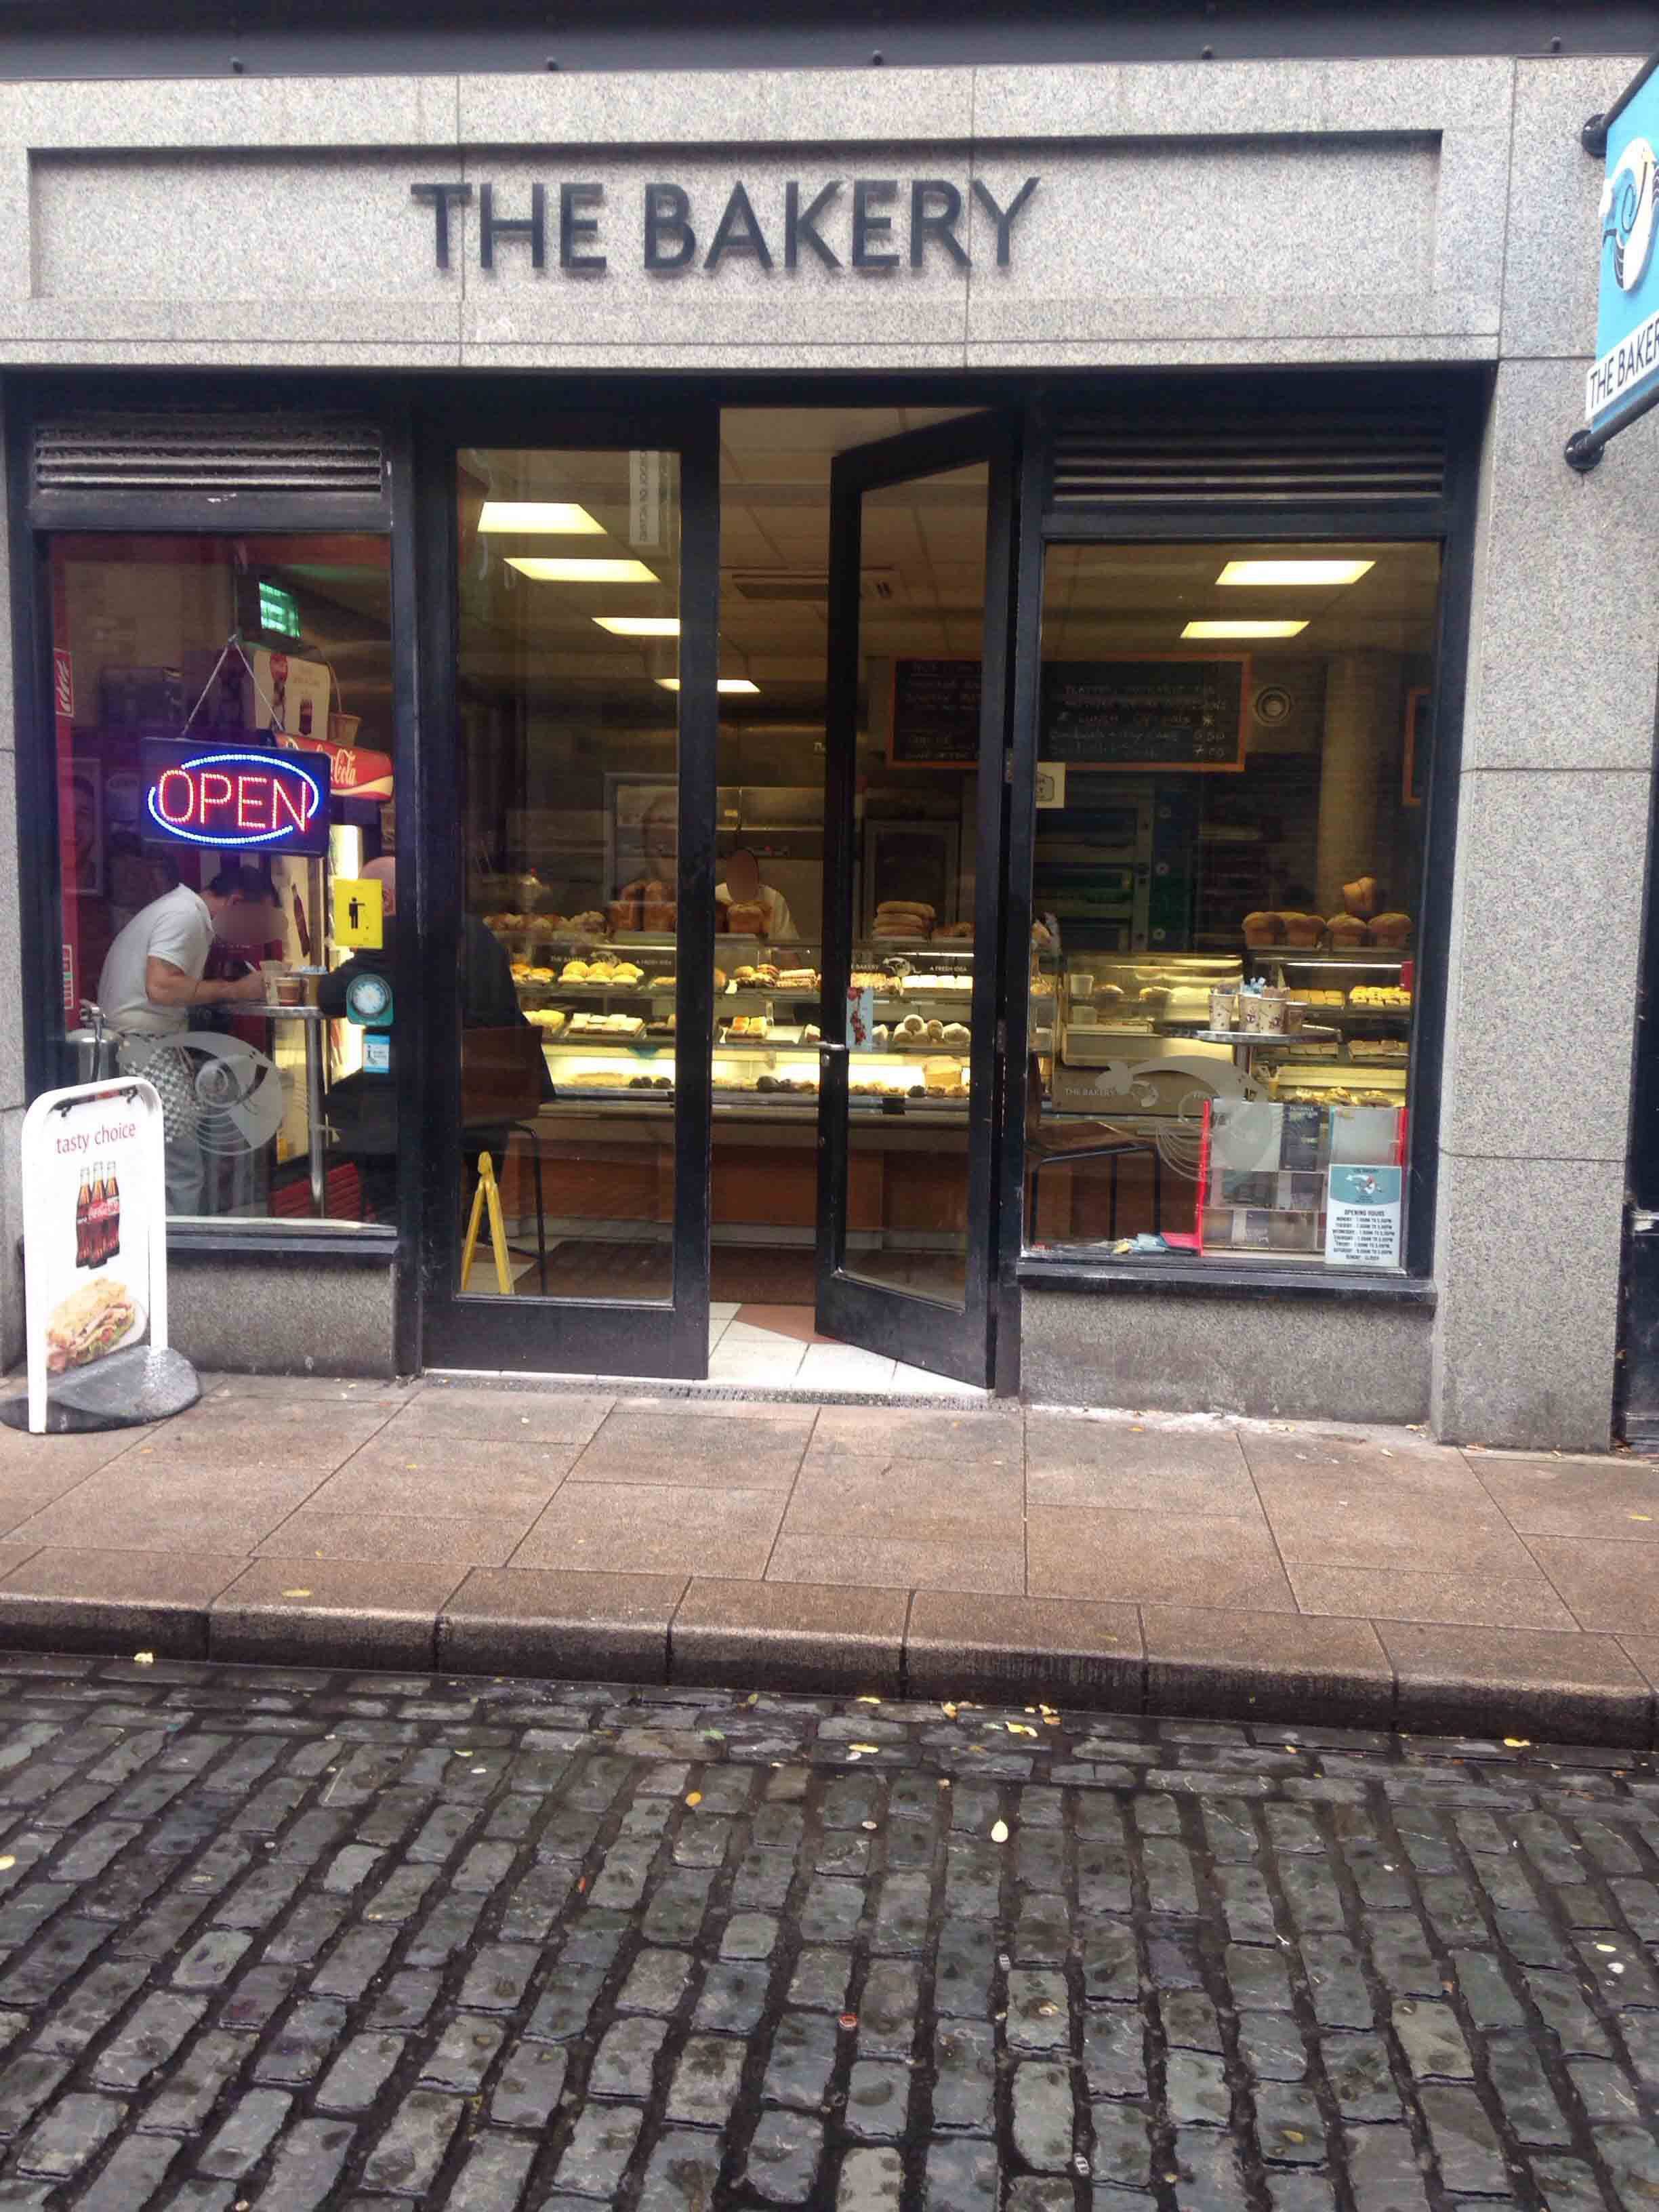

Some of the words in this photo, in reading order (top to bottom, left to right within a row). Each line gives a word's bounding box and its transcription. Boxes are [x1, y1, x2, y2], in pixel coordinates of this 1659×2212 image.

[411, 183, 608, 268] THE
[643, 177, 1041, 270] BAKERY
[1590, 356, 1614, 409] THE
[158, 769, 308, 832] OPEN
[56, 1133, 89, 1154] tasty
[94, 1122, 136, 1145] choice
